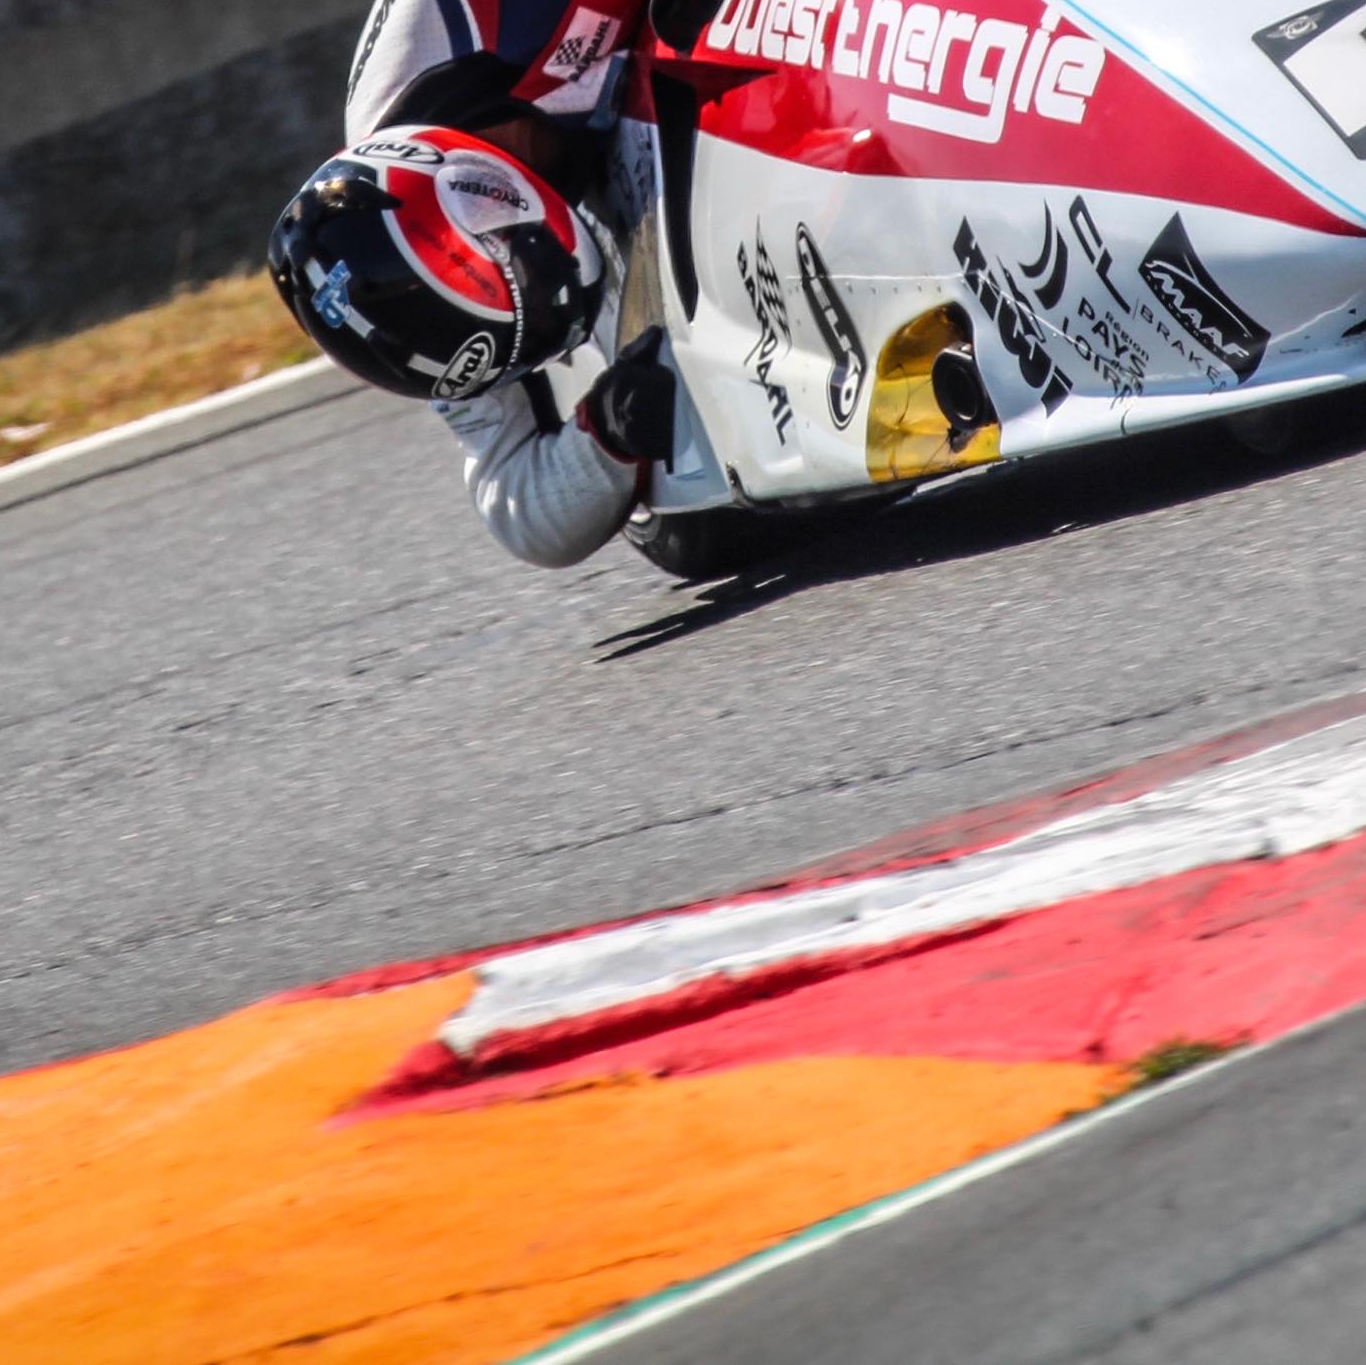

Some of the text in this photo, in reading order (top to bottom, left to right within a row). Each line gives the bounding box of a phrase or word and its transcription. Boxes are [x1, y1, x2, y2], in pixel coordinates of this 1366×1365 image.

[448, 180, 530, 212] CRYOTERA
[1068, 195, 1132, 315] CL
[737, 240, 794, 447] BARDAHL
[1078, 297, 1147, 379] PAYS
[1147, 270, 1250, 358] MAAF
[445, 346, 485, 395] Arai
